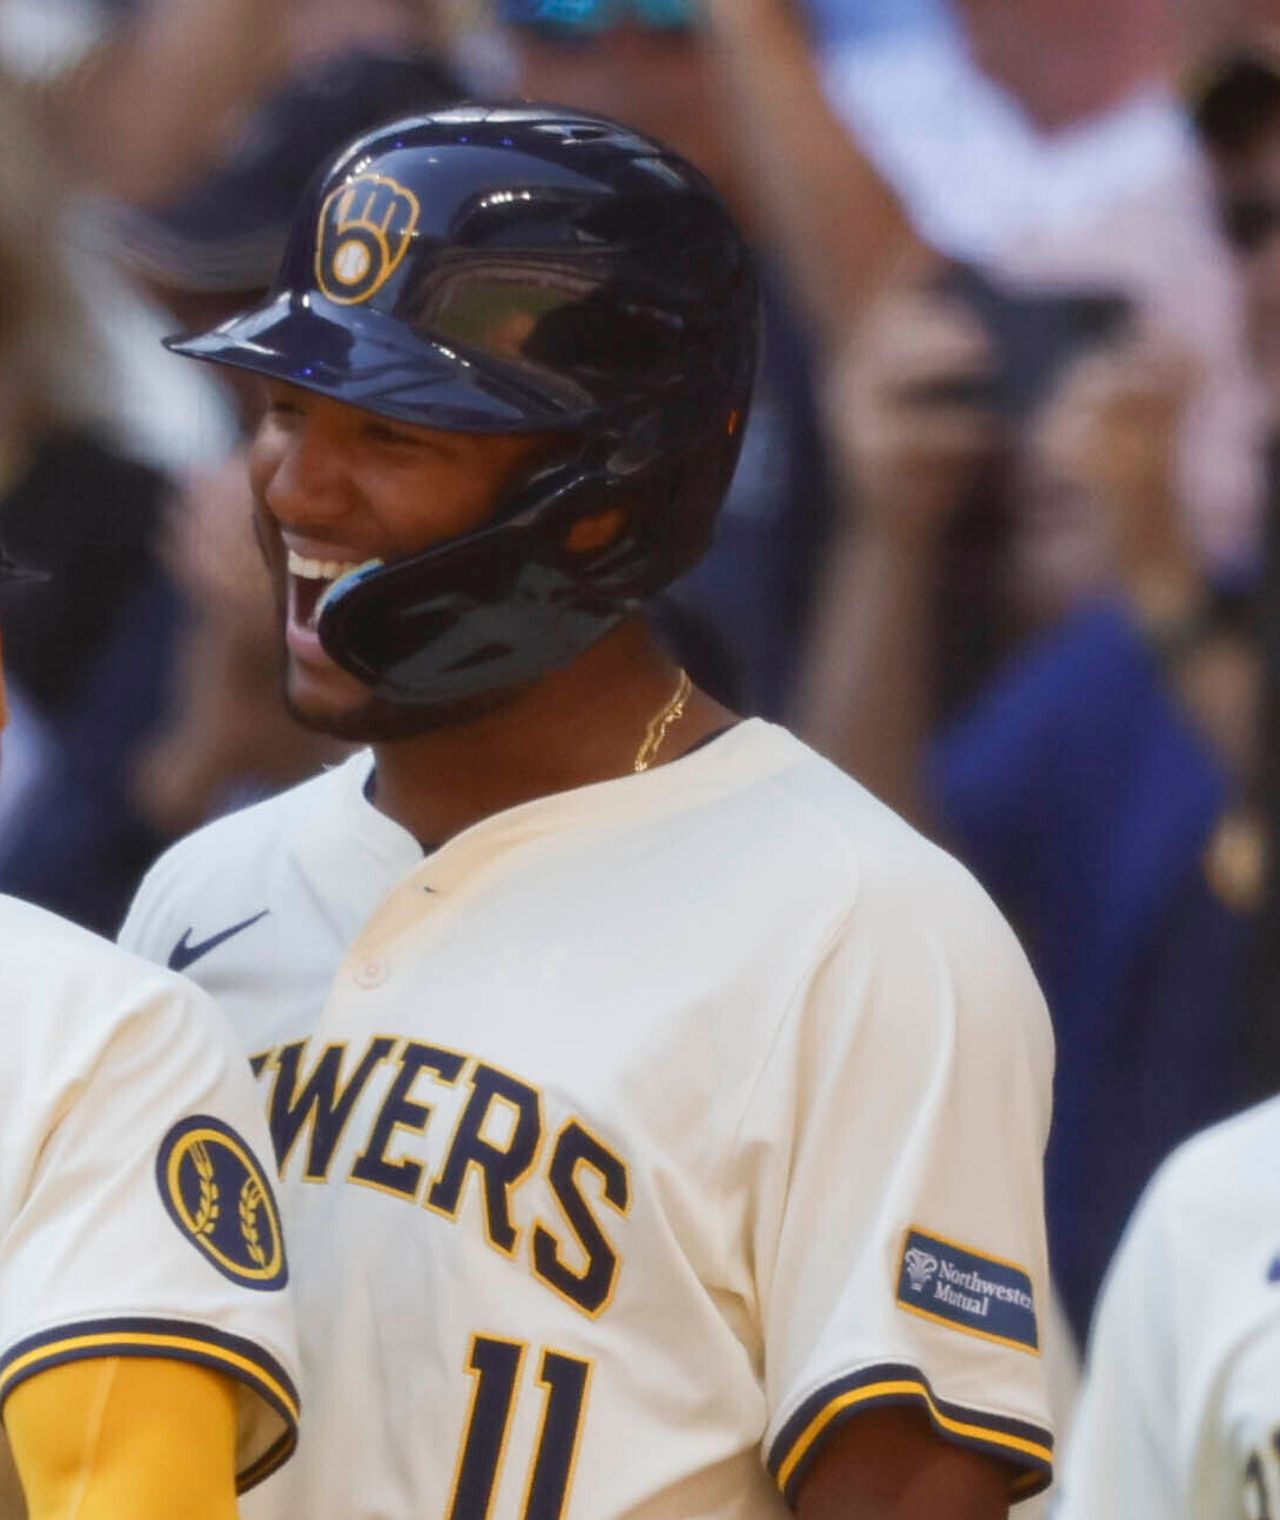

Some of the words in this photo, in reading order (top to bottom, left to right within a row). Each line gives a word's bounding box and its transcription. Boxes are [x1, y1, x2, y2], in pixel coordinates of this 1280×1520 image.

[249, 1033, 634, 1321] WERS
[934, 1280, 989, 1317] Mutual
[939, 1259, 1033, 1310] Northweste
